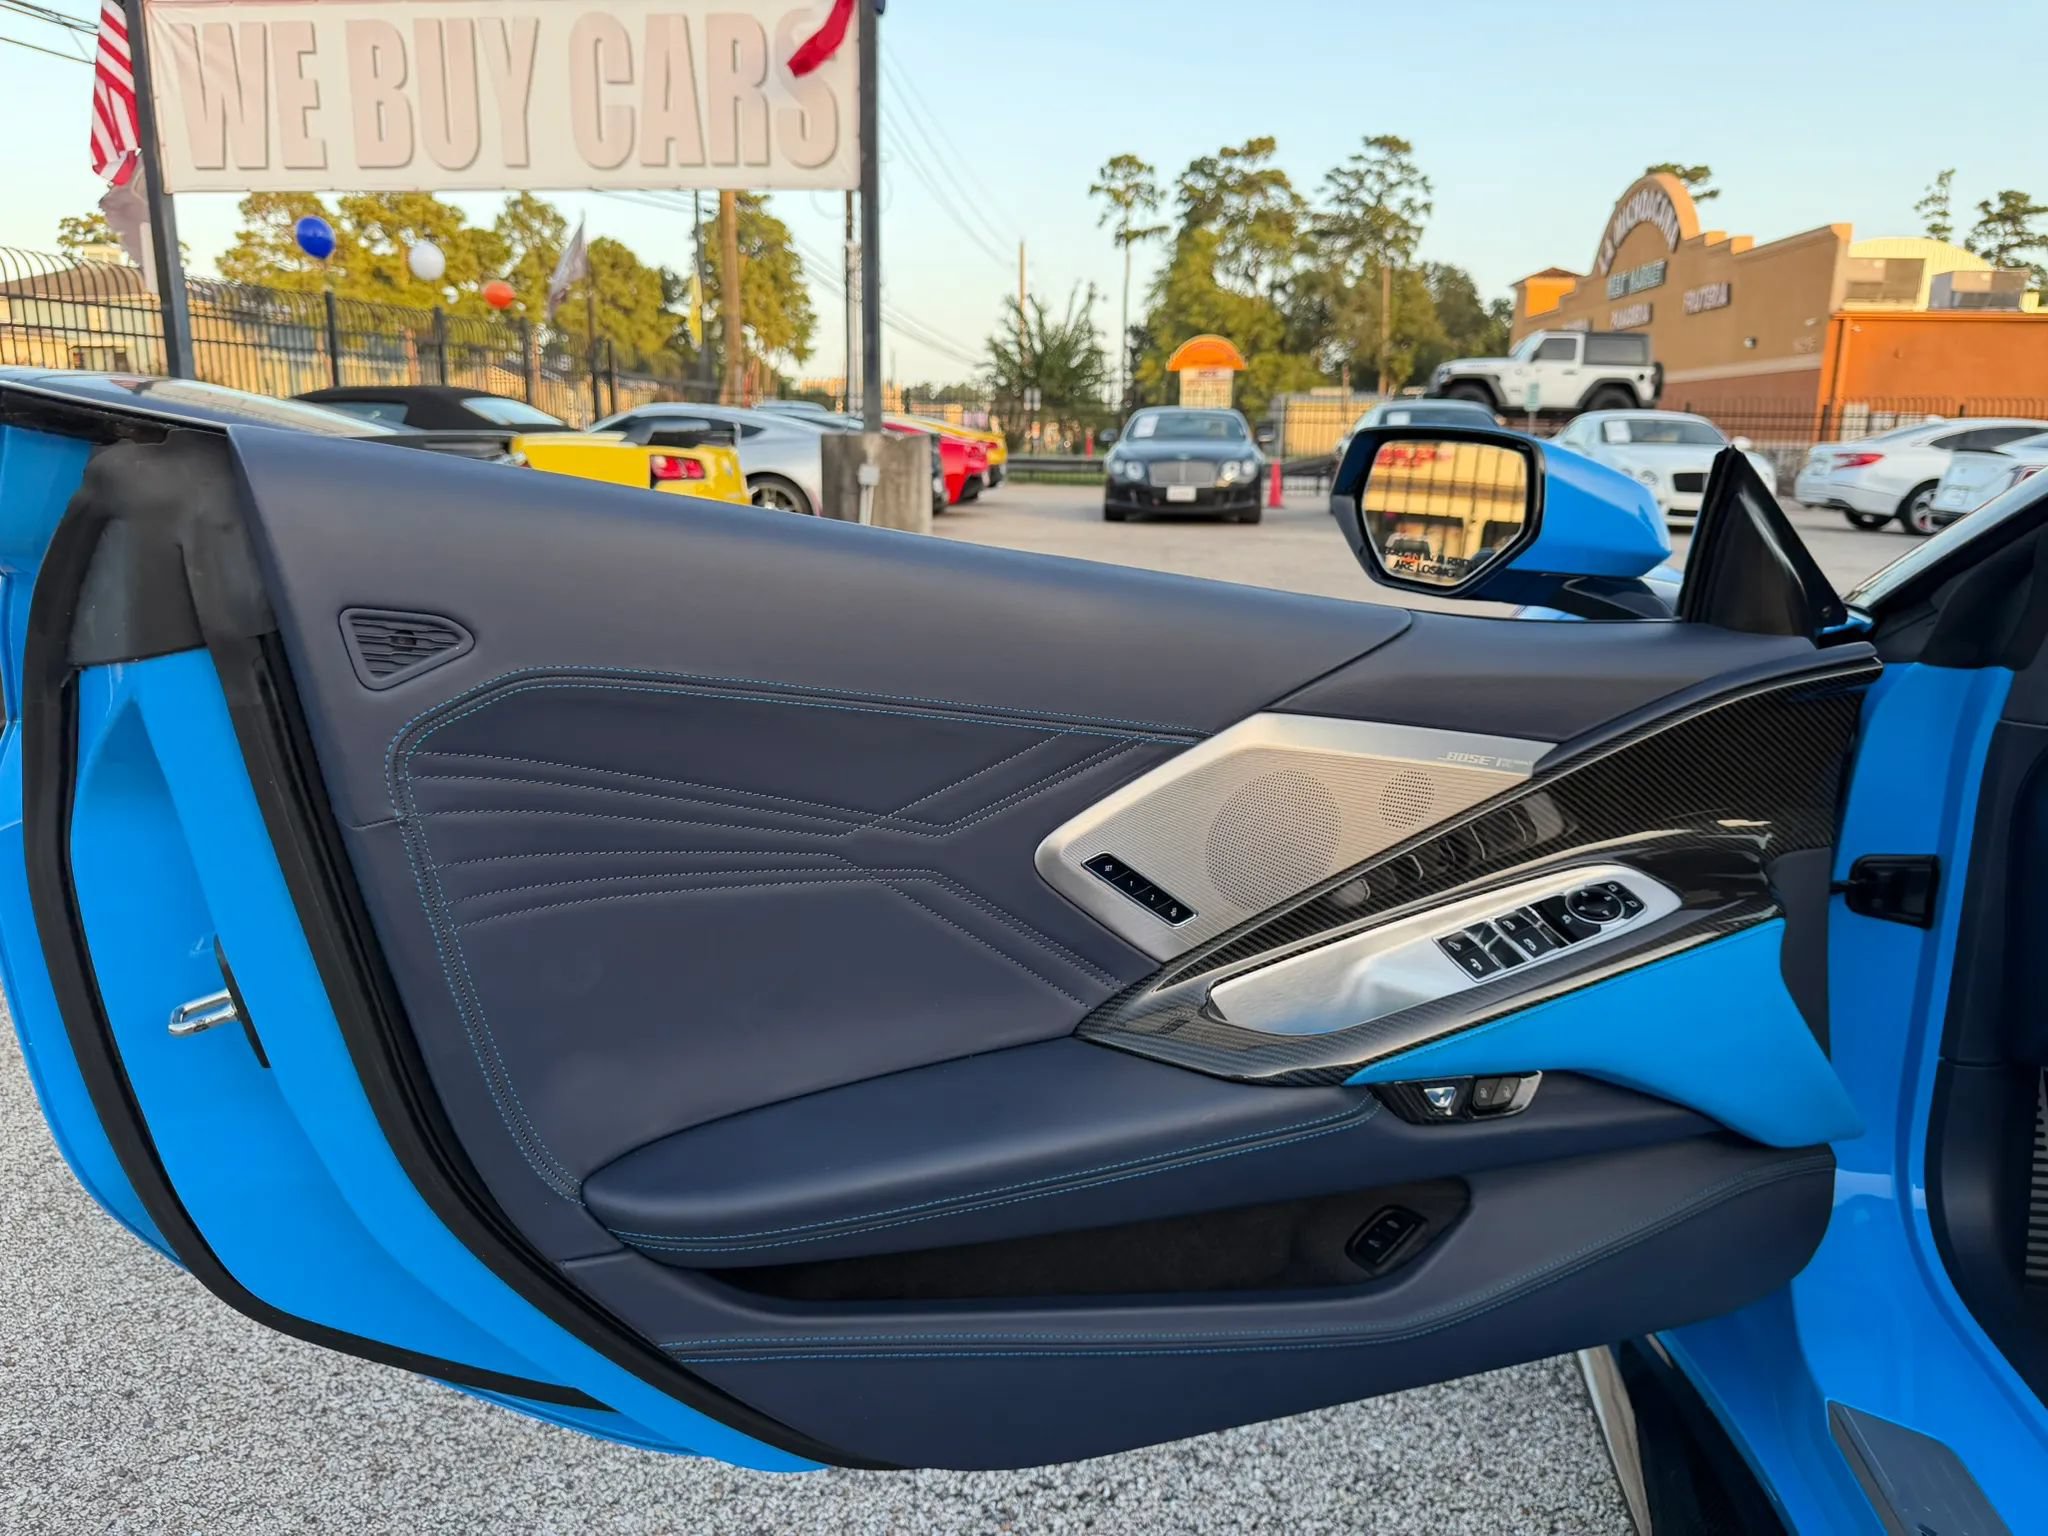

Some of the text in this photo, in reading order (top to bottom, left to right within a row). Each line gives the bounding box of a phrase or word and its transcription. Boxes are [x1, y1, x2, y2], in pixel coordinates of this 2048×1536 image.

[168, 9, 839, 172] WE BUY CARS
[1393, 560, 1414, 572] ARE
[1437, 751, 1496, 766] BOSE
[1104, 864, 1113, 872] SET
